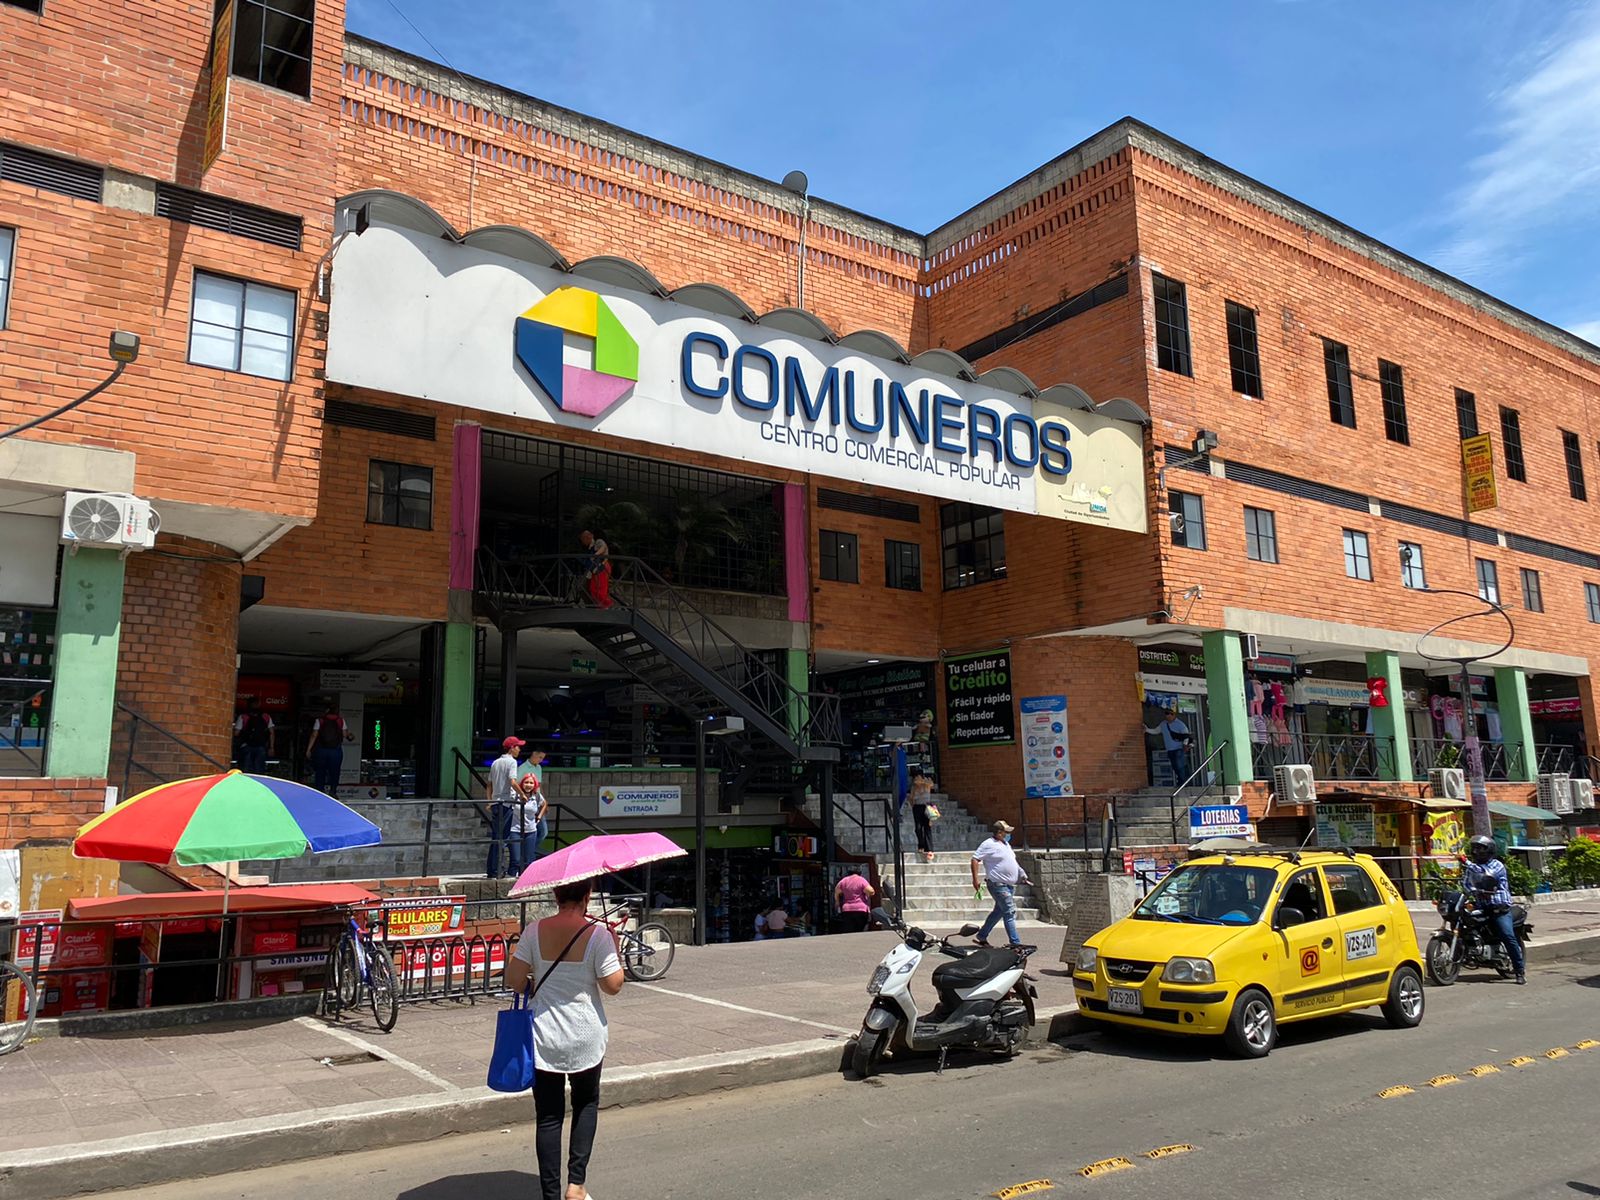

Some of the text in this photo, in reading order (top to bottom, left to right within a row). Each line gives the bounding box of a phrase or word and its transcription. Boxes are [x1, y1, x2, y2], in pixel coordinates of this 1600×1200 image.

[682, 331, 1072, 476] COMUNEROS
[760, 421, 1021, 491] CENTRO COMERCIAL POPULAR
[1139, 650, 1171, 662] DISTRITEC
[947, 658, 1006, 674] Tu celular a
[949, 670, 1007, 691] Crédito
[954, 692, 1011, 707] Fácil y rápido
[955, 710, 995, 722] Sin fiador
[956, 725, 1005, 738] Reportados
[1201, 809, 1240, 825] LOTERIAS
[387, 910, 448, 925] ELULARES
[1294, 999, 1316, 1009] SERVICIO
